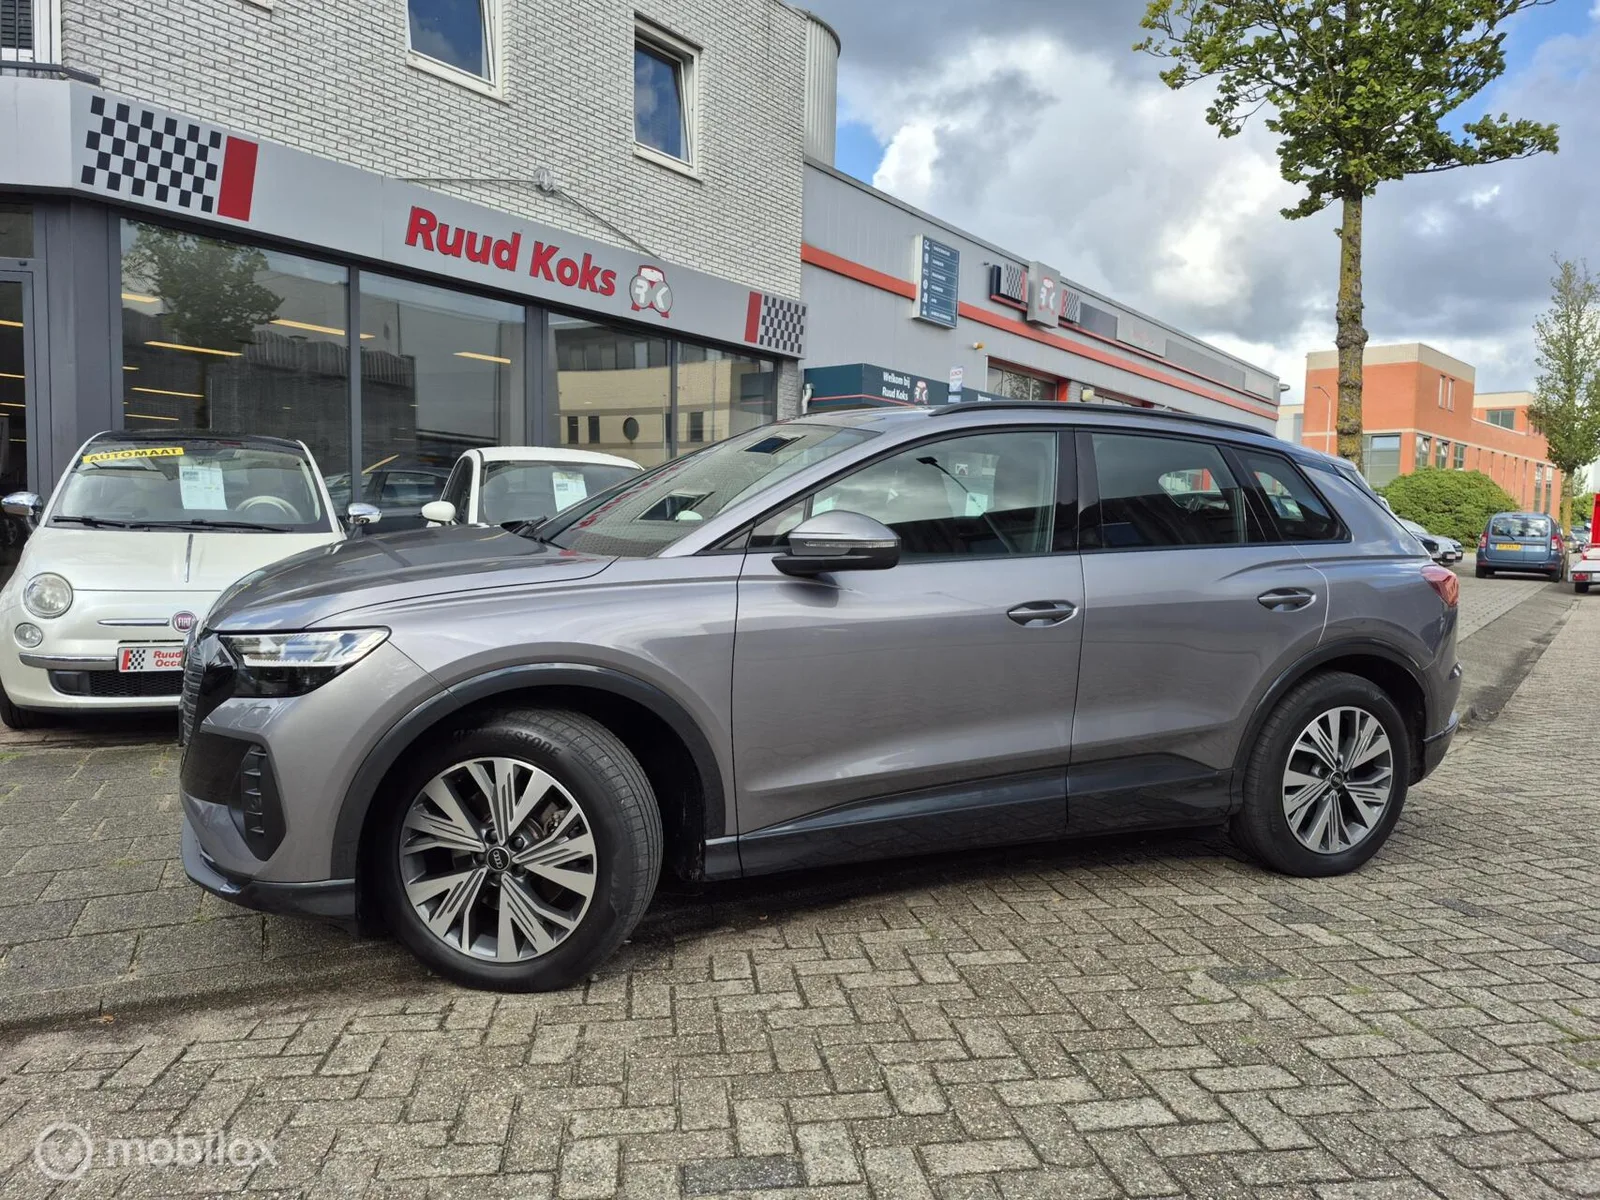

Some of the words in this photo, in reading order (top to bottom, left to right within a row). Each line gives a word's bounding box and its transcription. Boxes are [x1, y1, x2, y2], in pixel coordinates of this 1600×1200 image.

[404, 205, 521, 273] Ruud
[529, 240, 617, 297] Koks
[883, 371, 903, 386] Welkom
[903, 375, 911, 389] bij
[882, 386, 896, 398] Ruud
[896, 389, 909, 401] Koks
[89, 447, 178, 462] AUTOMAAT
[178, 617, 192, 629] FIAT
[153, 650, 184, 659] Ruud
